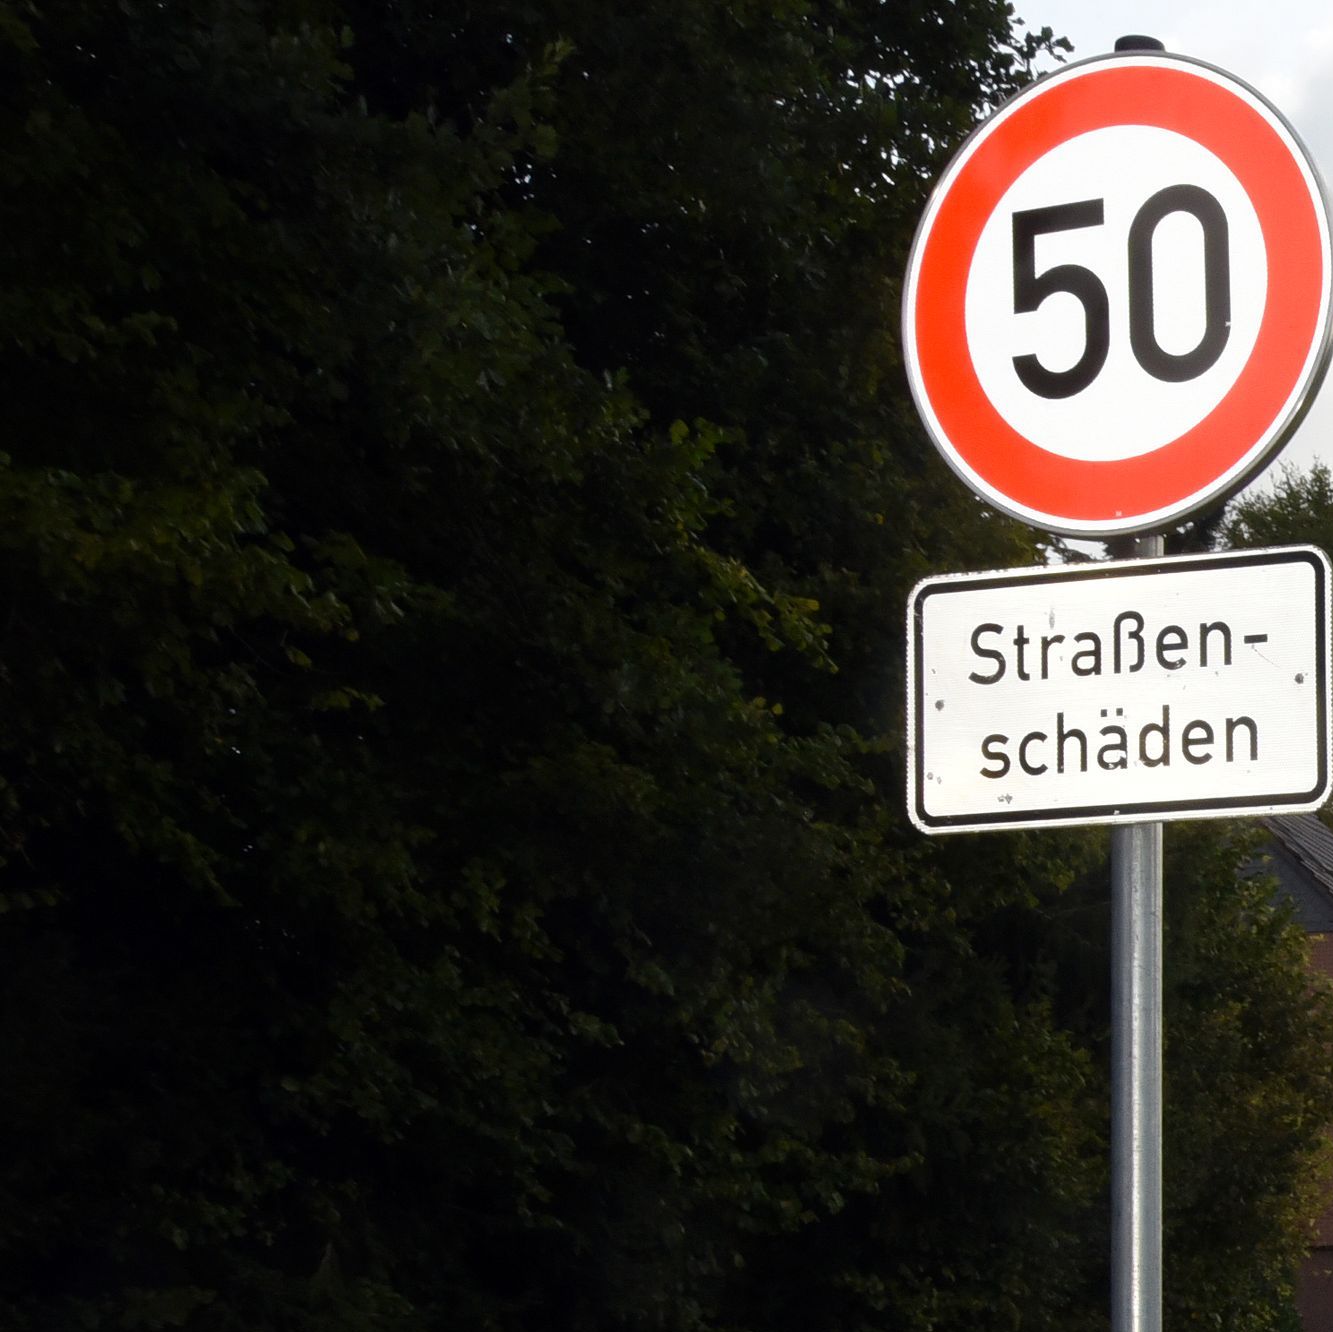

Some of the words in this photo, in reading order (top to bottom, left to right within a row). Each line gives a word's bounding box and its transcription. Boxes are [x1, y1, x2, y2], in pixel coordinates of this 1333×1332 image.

[1012, 184, 1231, 400] 50
[968, 610, 1269, 685] Straßen-
[980, 704, 1259, 779] schäden
